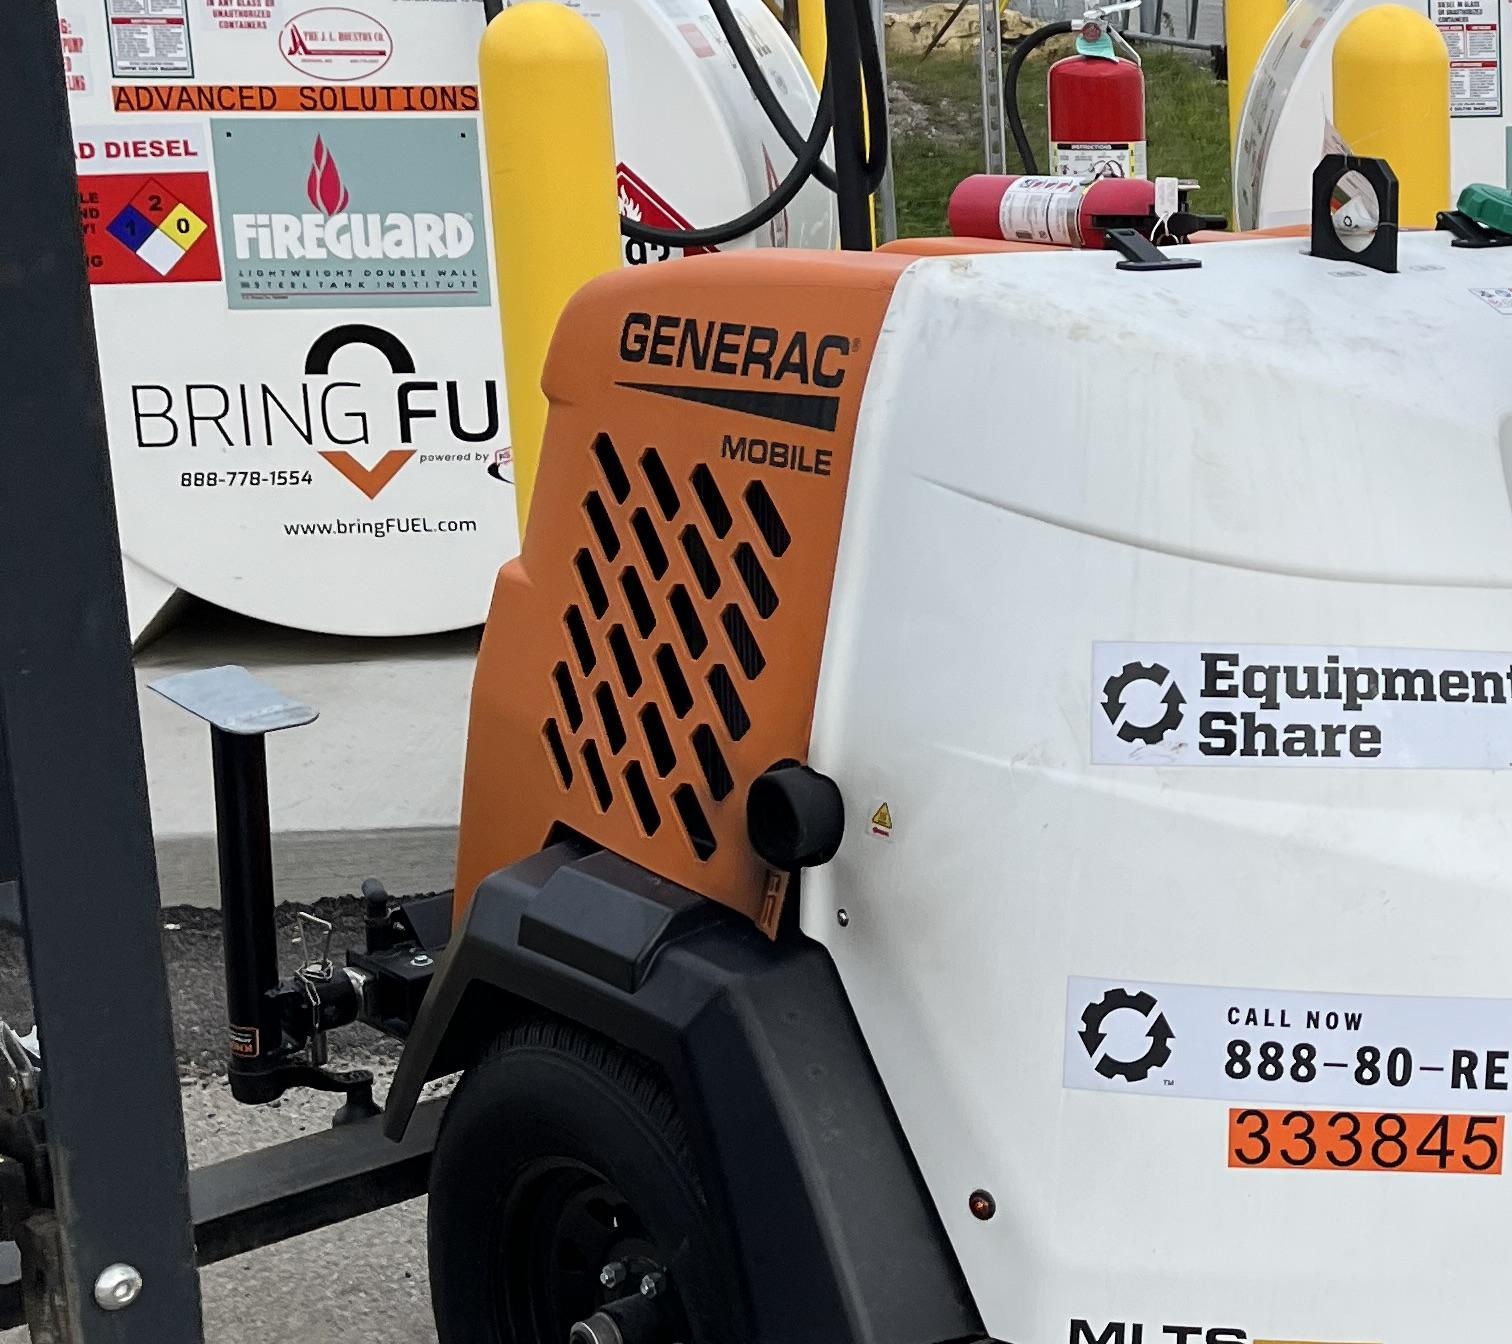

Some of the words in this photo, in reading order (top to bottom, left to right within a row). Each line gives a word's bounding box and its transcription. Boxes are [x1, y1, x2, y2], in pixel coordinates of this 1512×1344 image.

[115, 86, 278, 111] ADVANCED
[299, 86, 479, 111] SOLUTIONS
[104, 139, 198, 158] DIESEL
[148, 195, 163, 211] 2
[126, 221, 136, 236] 1
[176, 218, 190, 233] 0
[238, 269, 353, 277] LIGHTWEIGHT
[364, 269, 426, 277] DOUBLE
[438, 269, 478, 277] WALL
[254, 281, 308, 289] STEEL
[319, 281, 366, 289] TANK
[376, 280, 478, 289] INSTITUTE
[620, 312, 850, 388] GENERAC
[131, 381, 369, 447] BRING
[397, 380, 499, 443] FU
[420, 453, 471, 464] powered
[475, 452, 489, 463] by
[720, 435, 833, 475] MOBILE
[180, 470, 313, 488] 888-778-1554
[284, 517, 477, 538] www.bringFUEL.com
[1199, 710, 1382, 757] Share
[1228, 1007, 1291, 1028] CALL
[1306, 1011, 1363, 1031] NOW
[1234, 1109, 1498, 1171] 333845
